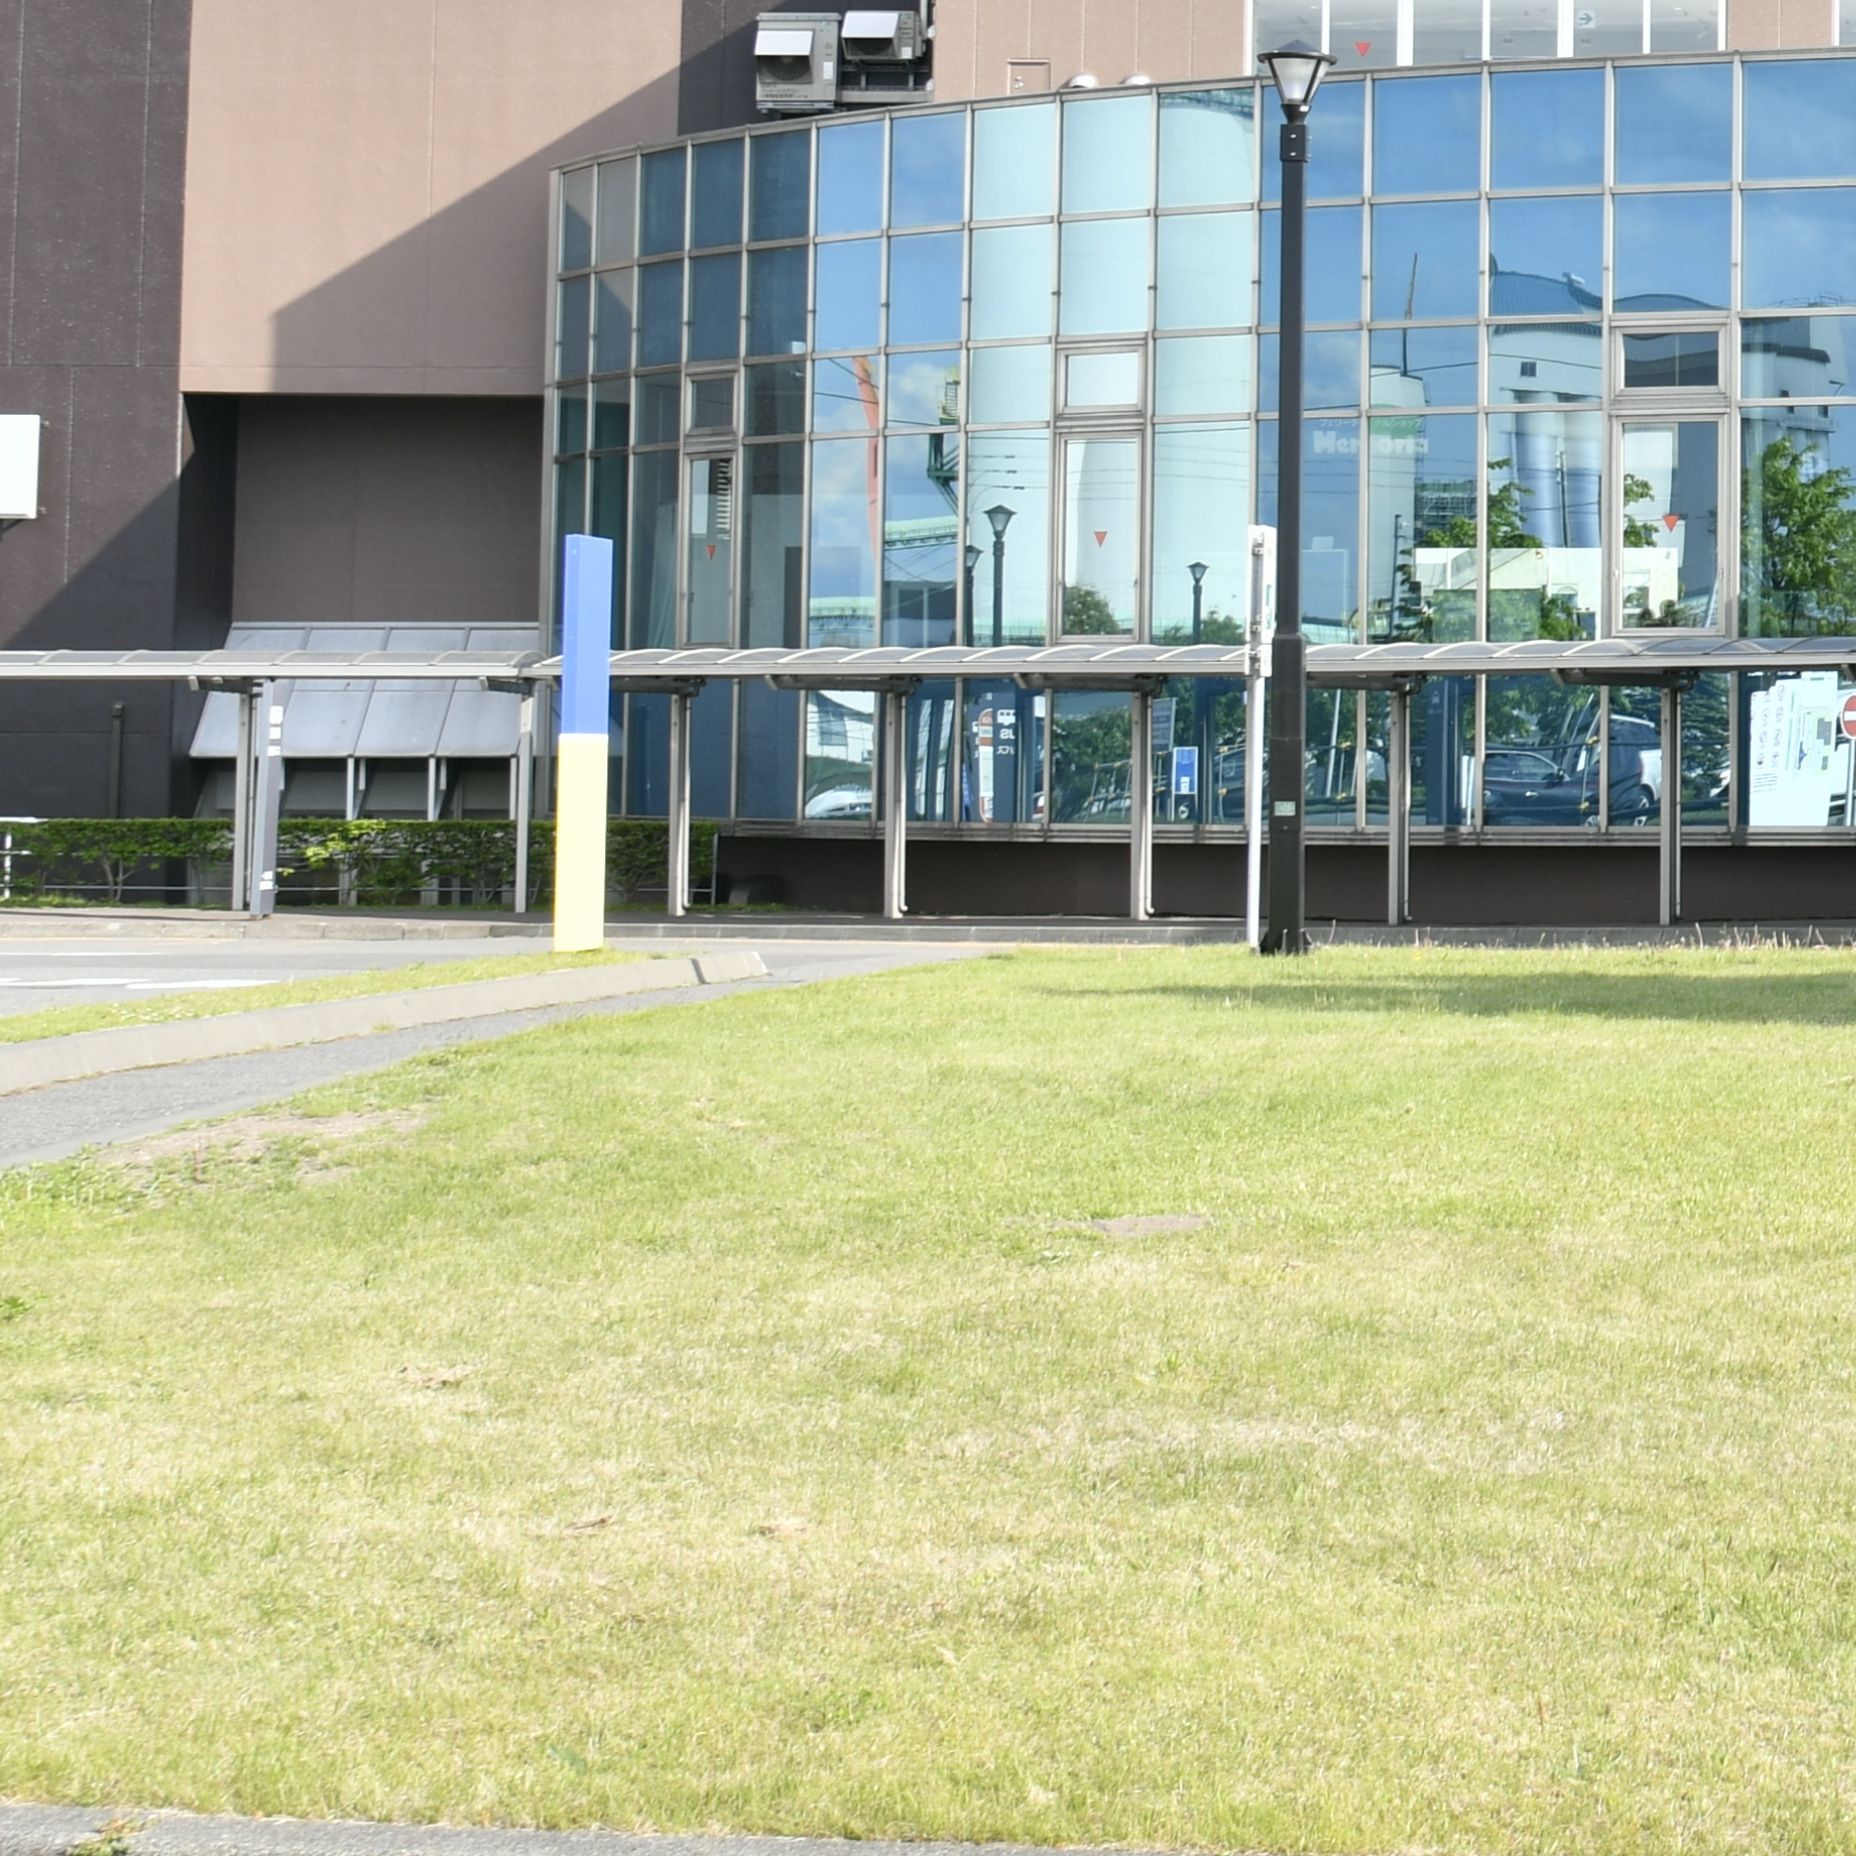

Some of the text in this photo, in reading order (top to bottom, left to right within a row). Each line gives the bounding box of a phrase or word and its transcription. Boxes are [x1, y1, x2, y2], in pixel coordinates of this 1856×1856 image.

[1319, 418, 1422, 428] フェリータナルショップ
